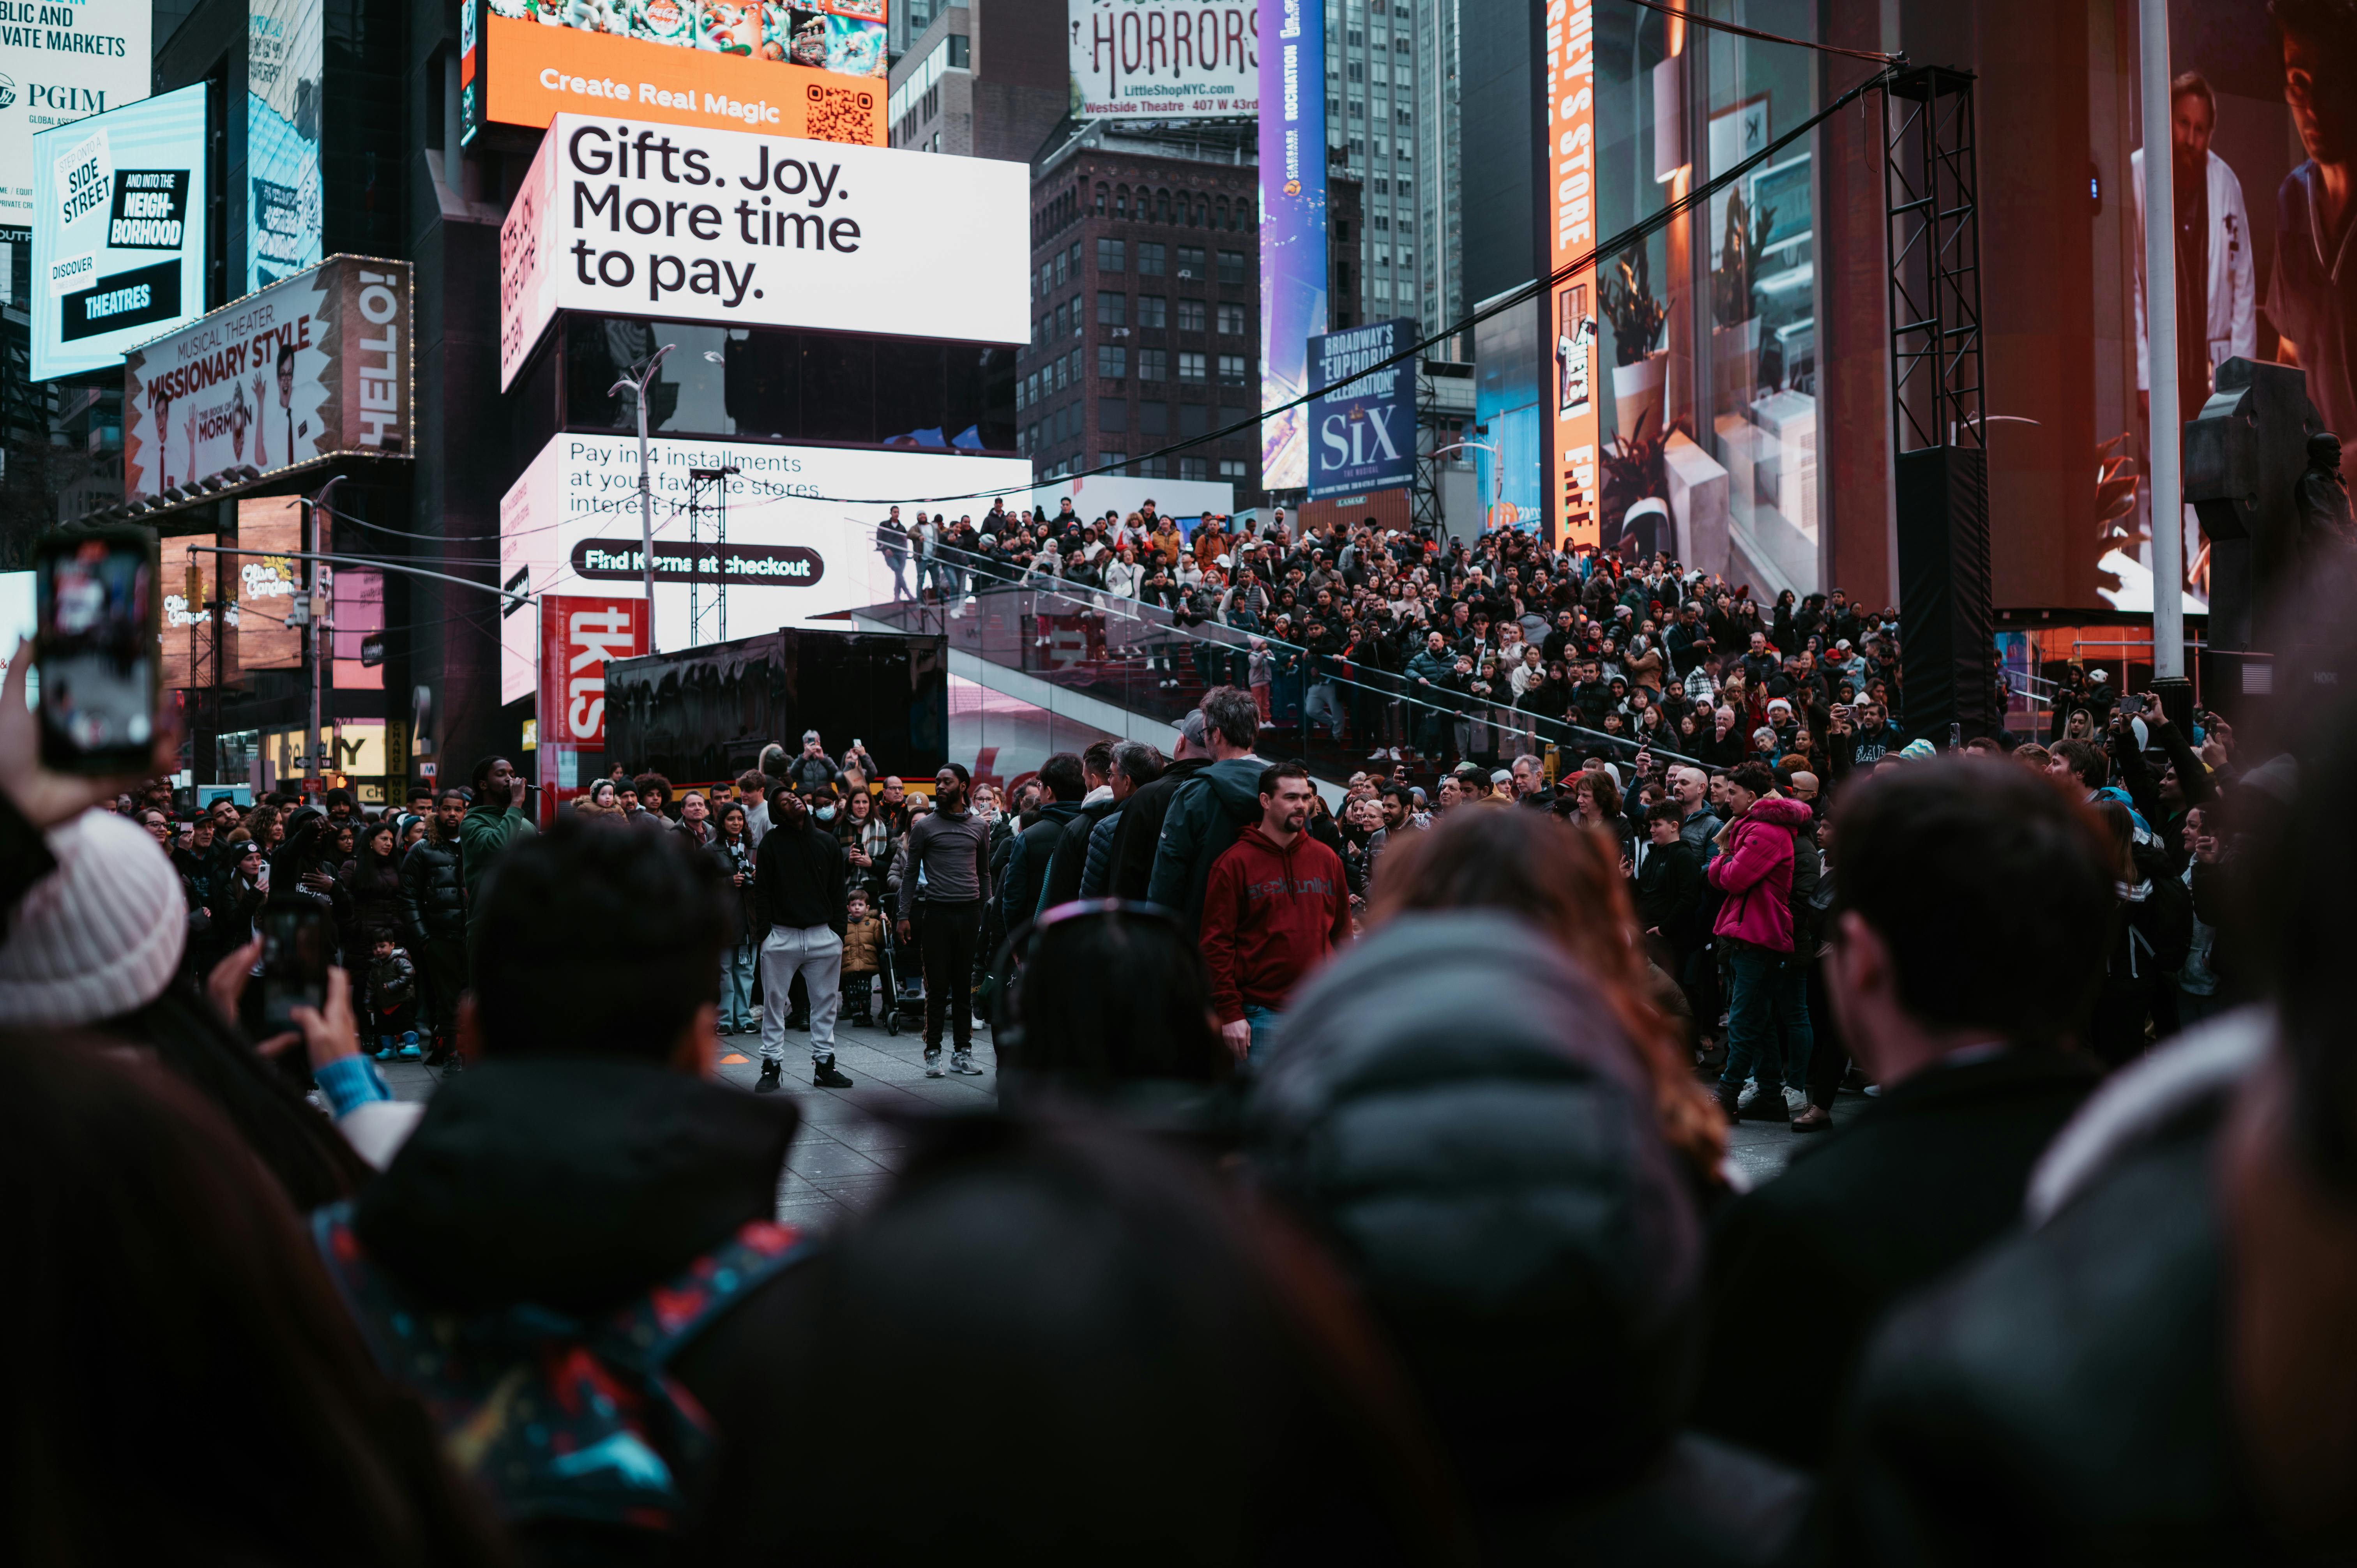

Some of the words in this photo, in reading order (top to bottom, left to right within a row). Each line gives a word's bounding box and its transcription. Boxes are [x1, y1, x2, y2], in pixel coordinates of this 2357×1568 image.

[39, 5, 73, 27] AND
[47, 30, 125, 57] MARKETS
[27, 83, 106, 113] PGIM
[540, 68, 631, 100] Create
[639, 82, 697, 111] Real
[704, 93, 780, 124] Magic
[1125, 84, 1234, 97] LittleShopNYC.com
[29, 115, 55, 125] GLOBAL
[1085, 101, 1137, 113] Westside
[1141, 101, 1184, 111] Theatre
[1193, 100, 1212, 110] 407
[1218, 99, 1228, 109] W
[59, 153, 76, 173] STEP
[77, 143, 94, 161] ONTO
[95, 137, 101, 147] A
[569, 125, 726, 187] Gifts.
[739, 145, 848, 208] Joy.
[69, 156, 99, 194] SIDE
[126, 174, 142, 188] AND
[142, 174, 159, 188] INTO
[159, 174, 176, 188] THE
[1559, 123, 1590, 251] STORE
[63, 175, 110, 223] STREET
[124, 192, 175, 218] NEIGH-
[573, 181, 722, 240] More
[734, 196, 861, 253] time
[111, 219, 182, 246] BORHOOD
[53, 256, 92, 280] DISCOVER
[570, 239, 634, 288] to
[650, 254, 764, 308] pay.
[85, 283, 150, 320] THEATRES
[178, 327, 221, 362] MUSICAL
[225, 304, 275, 340] THEATER.
[1325, 324, 1394, 357] BROADWAY'S
[148, 339, 249, 409] MISSIONARY
[252, 314, 313, 368] STYLE.
[359, 270, 397, 445] HELLO!
[199, 410, 208, 420] THE
[209, 405, 224, 416] BOOK
[224, 401, 232, 411] OF
[199, 404, 252, 443] MORMN
[571, 443, 611, 466] Pay
[620, 444, 638, 464] in
[647, 447, 659, 464] 4
[668, 447, 801, 473] installments
[571, 471, 592, 487] at
[601, 473, 641, 492] you
[242, 563, 277, 583] Olive
[586, 550, 628, 569] Find
[633, 551, 692, 572] Karna
[698, 556, 719, 573] at
[725, 555, 810, 576] checkout
[164, 595, 189, 611] Oliv
[246, 579, 295, 600] Garden
[569, 606, 633, 739] tkts
[558, 677, 566, 721] development
